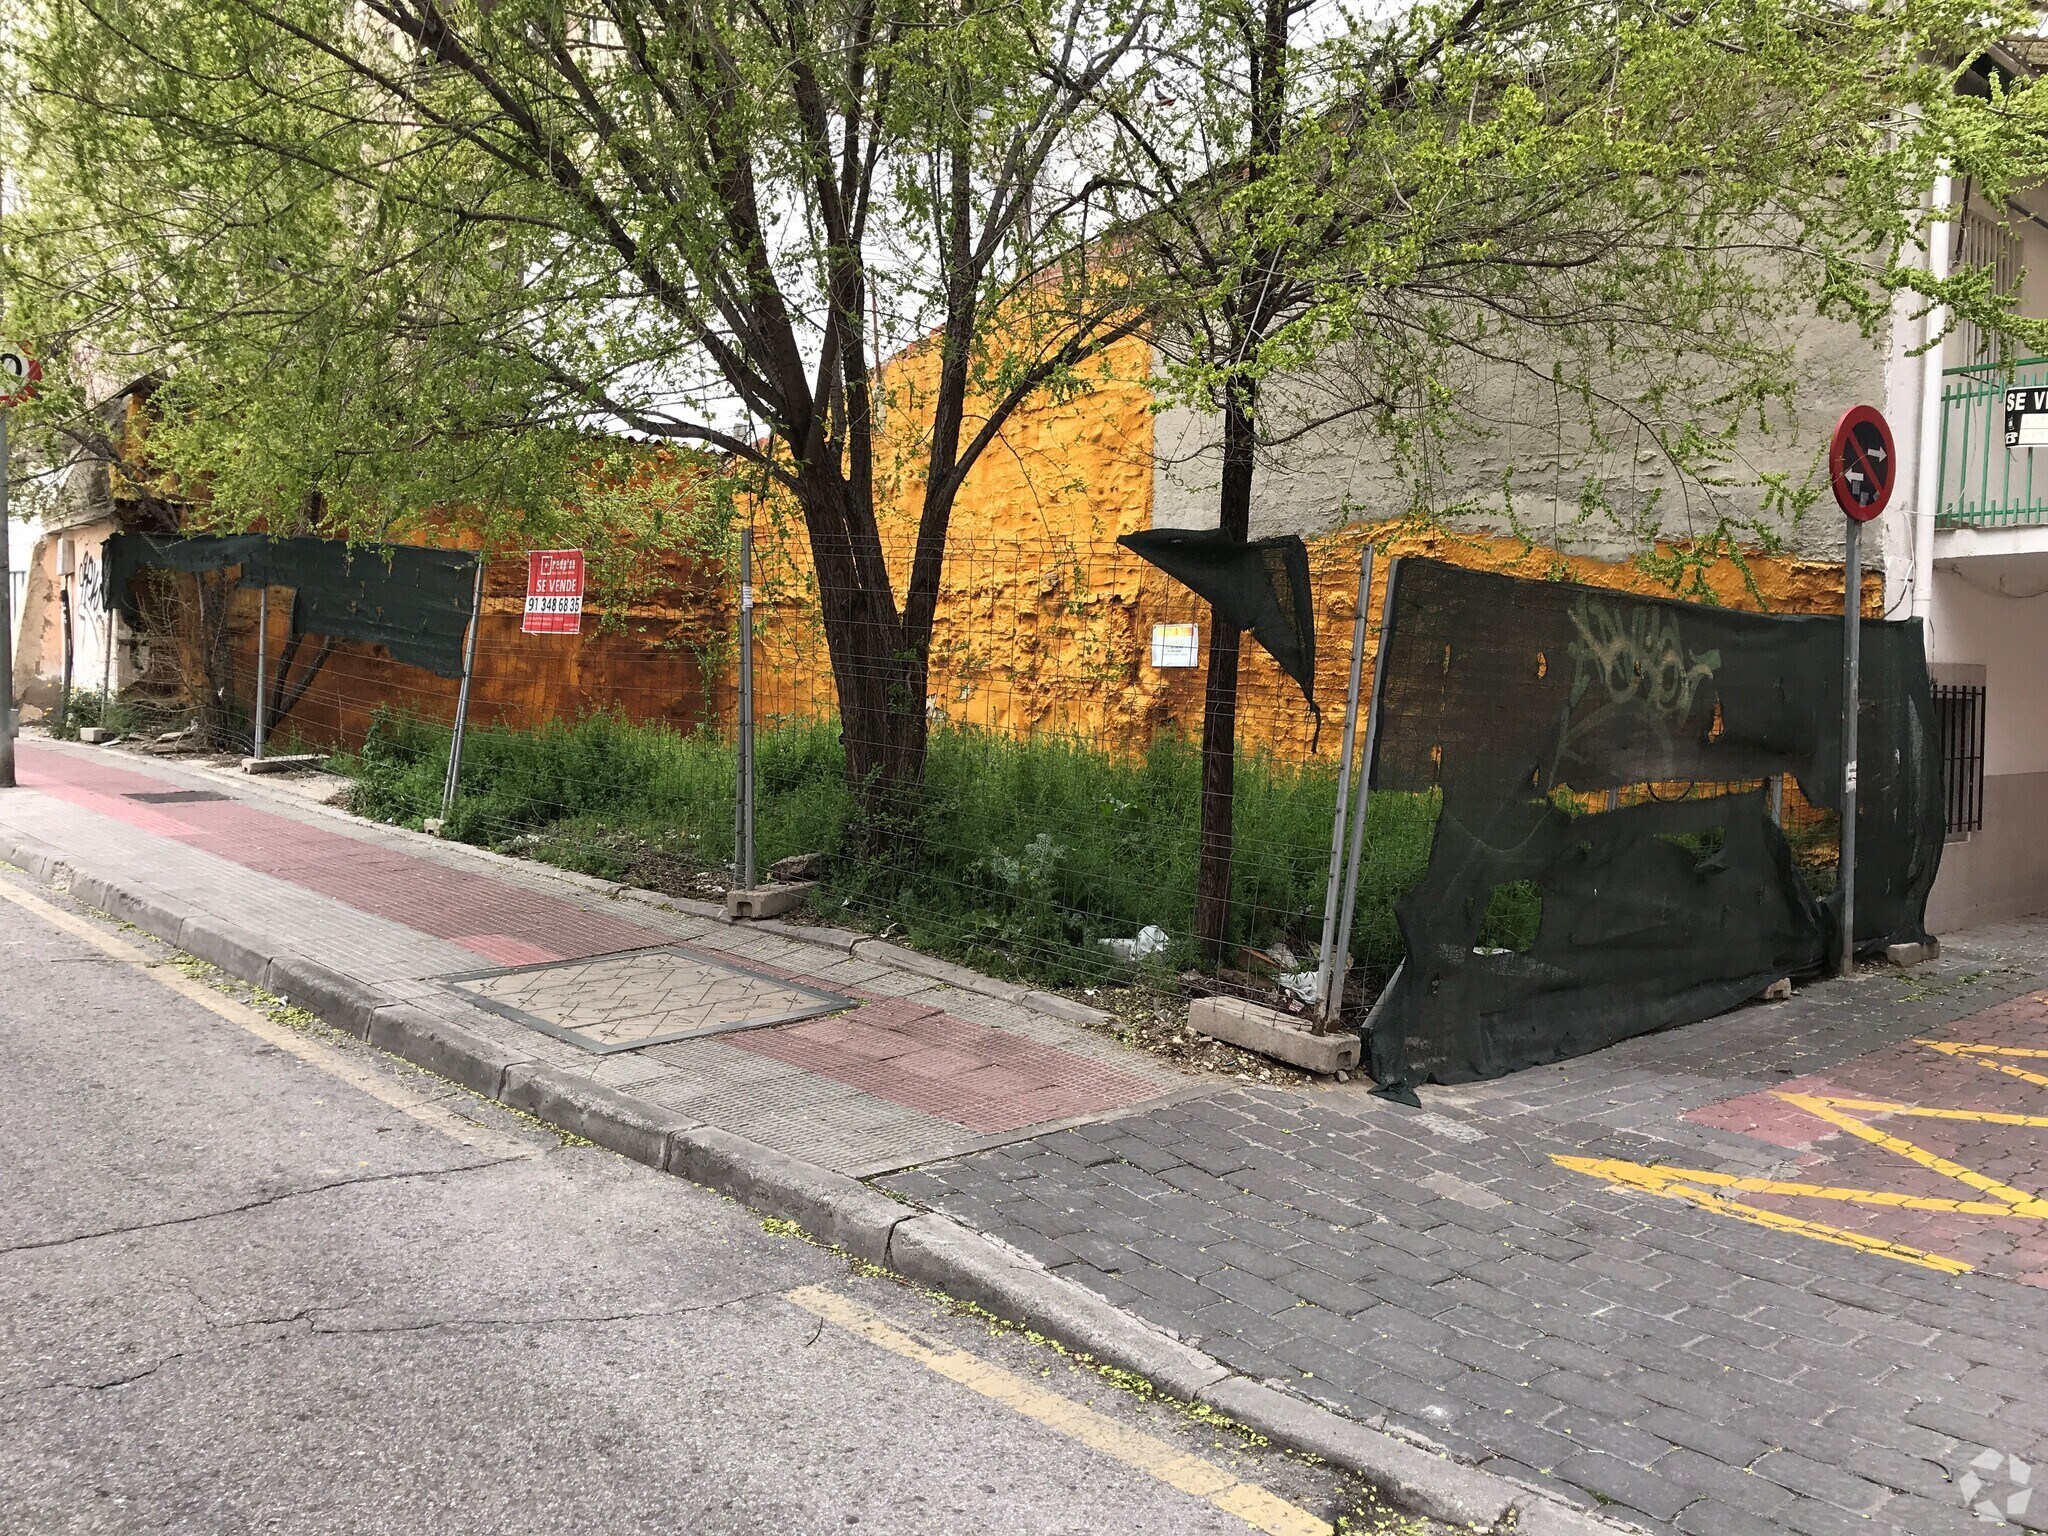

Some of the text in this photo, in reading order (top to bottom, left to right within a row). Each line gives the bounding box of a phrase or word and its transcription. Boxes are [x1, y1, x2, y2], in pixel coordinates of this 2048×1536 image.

[2007, 391, 2048, 411] SE V
[536, 578, 577, 592] SE VENDE
[528, 597, 580, 612] 91 348 68 35
